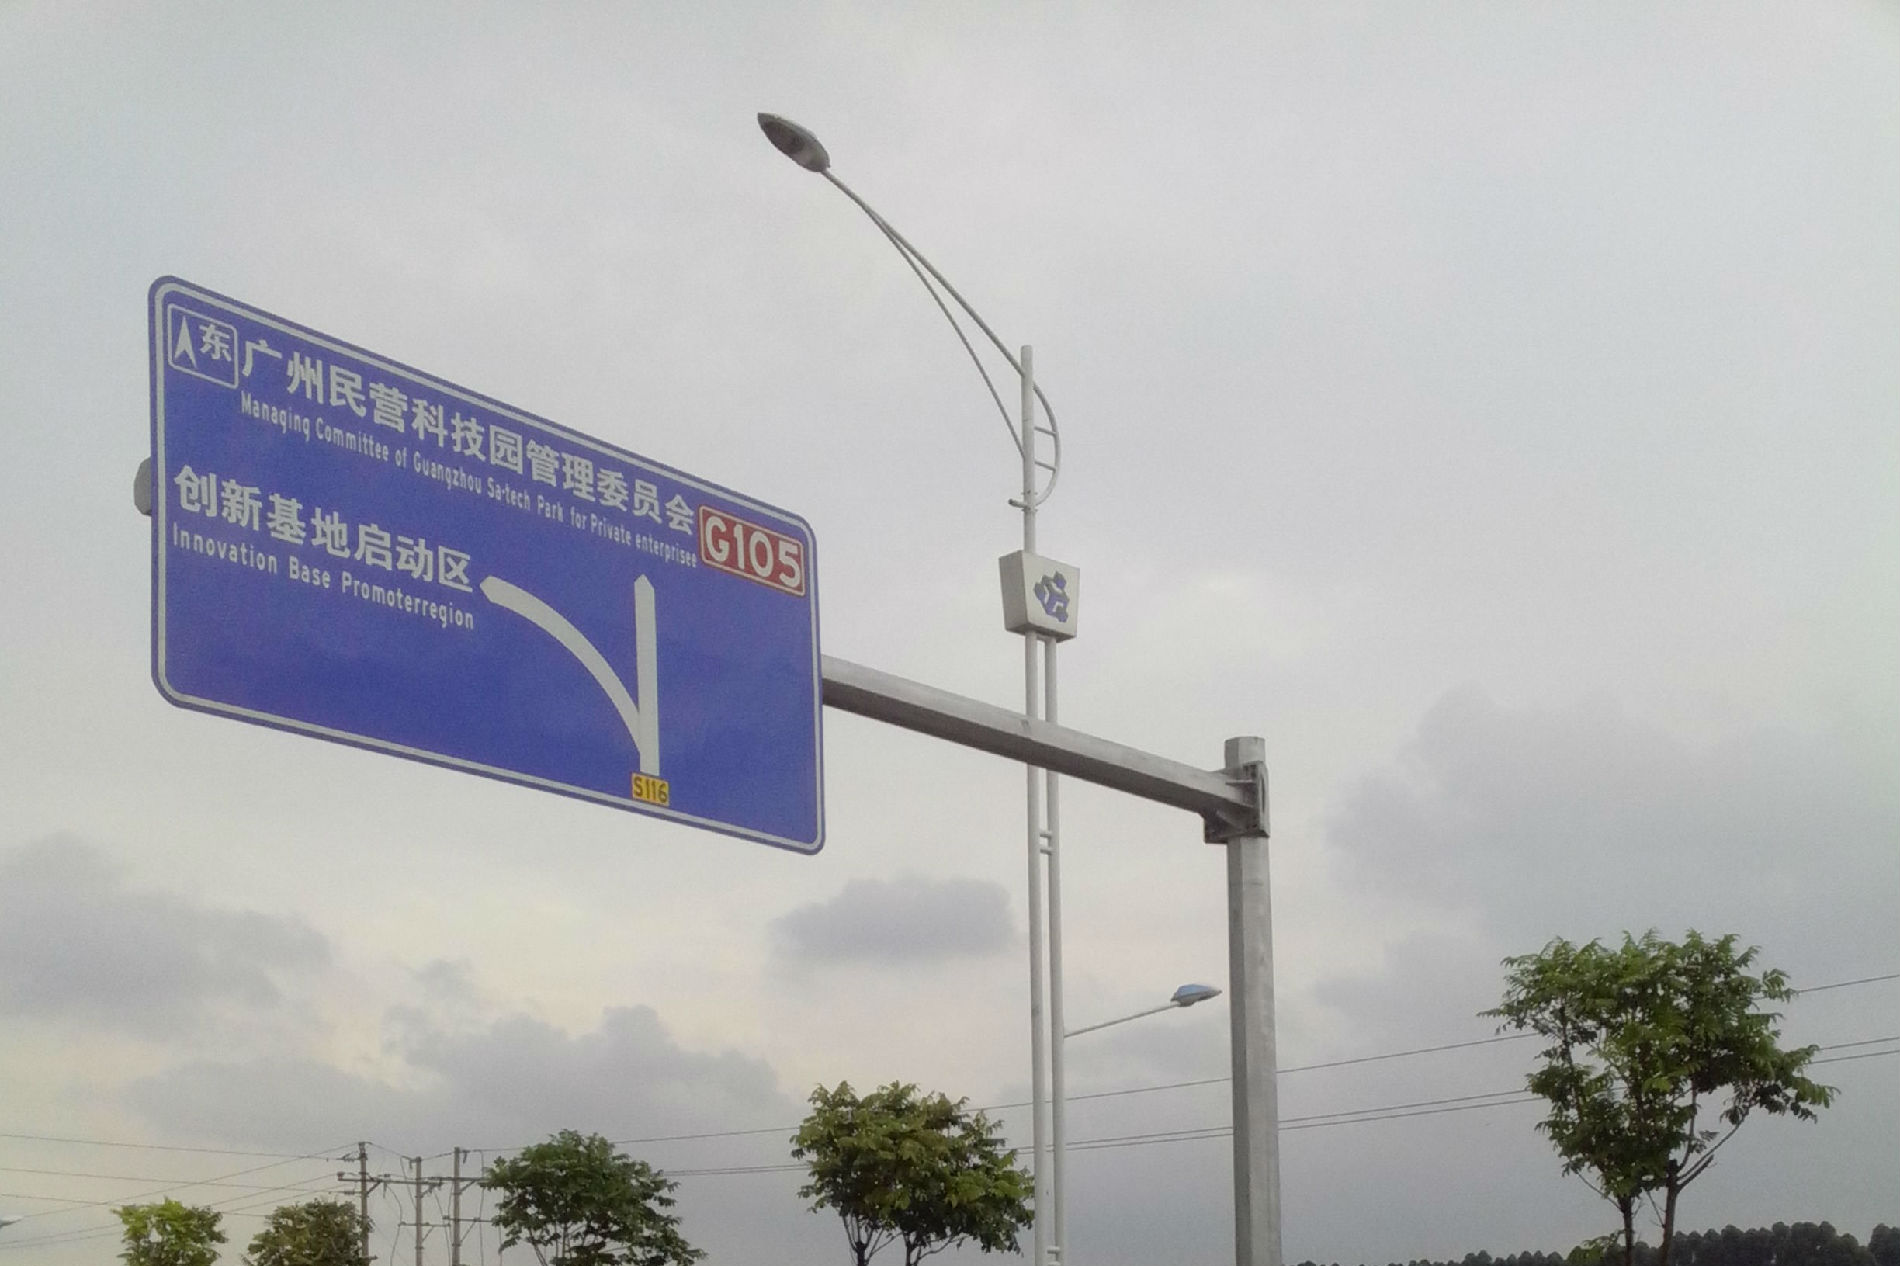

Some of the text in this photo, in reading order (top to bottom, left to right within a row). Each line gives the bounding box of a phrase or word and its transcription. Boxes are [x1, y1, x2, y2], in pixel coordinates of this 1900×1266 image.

[241, 390, 311, 442] Managing
[316, 417, 389, 461] Committee
[395, 447, 407, 469] of
[414, 451, 482, 494] Guangzhou
[537, 494, 564, 522] Park
[570, 505, 587, 530] for
[591, 513, 631, 547] Private
[242, 339, 694, 536] 广州民营科技园管理委员会
[173, 522, 475, 630] Innovation Base Promoterregion
[174, 464, 474, 593] 创新基地启动区
[705, 516, 802, 588] G105
[634, 776, 668, 804] S116
